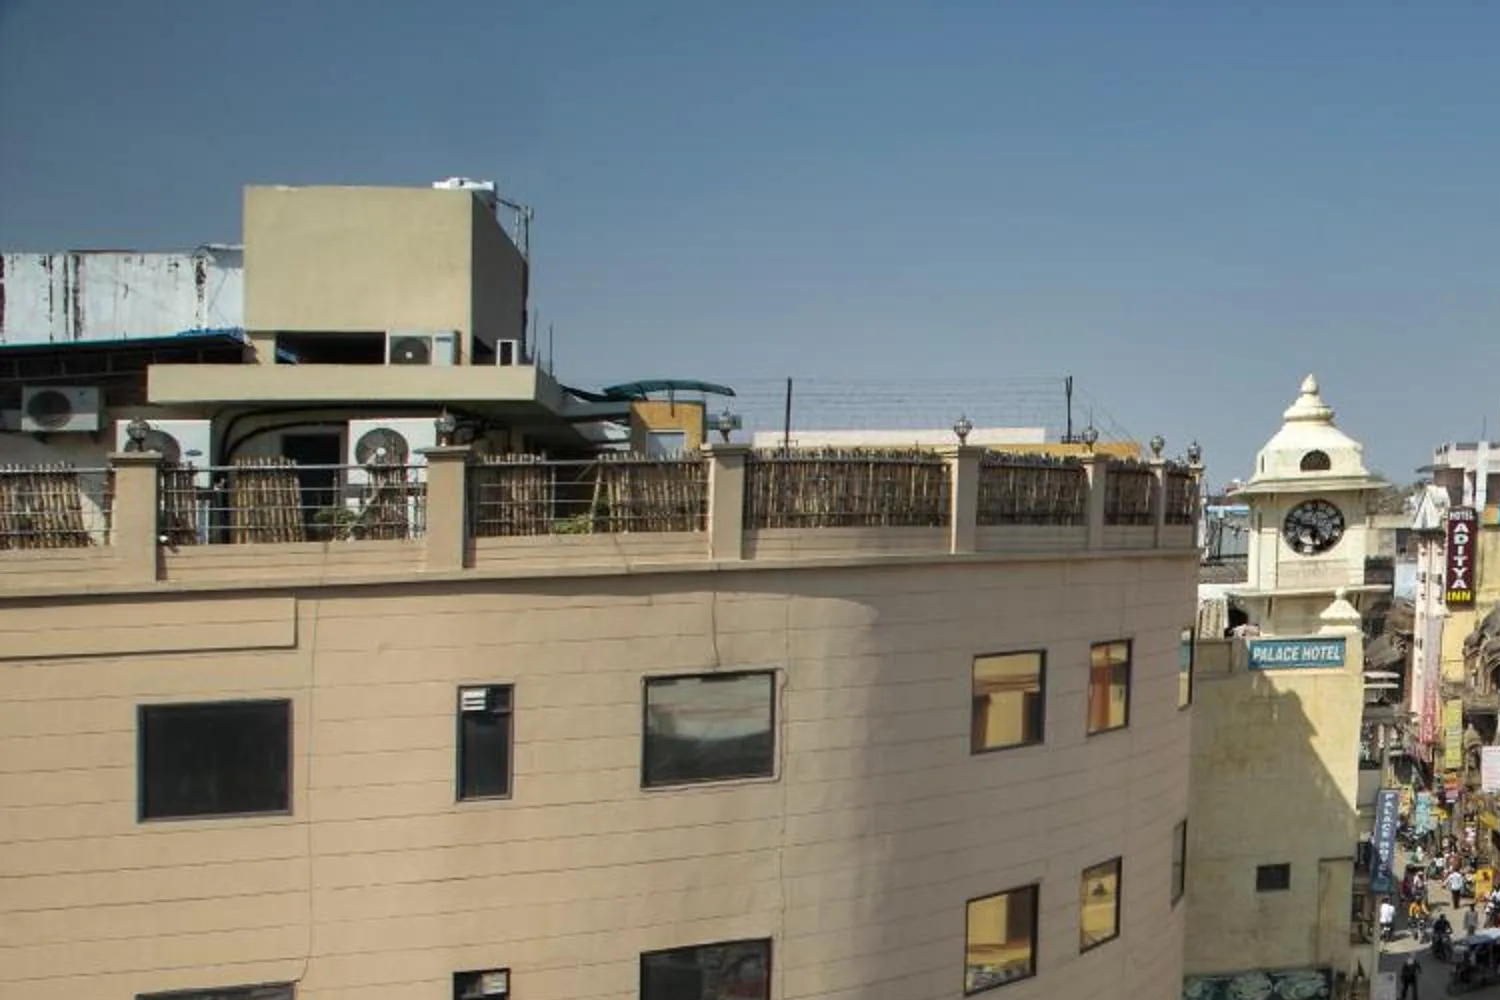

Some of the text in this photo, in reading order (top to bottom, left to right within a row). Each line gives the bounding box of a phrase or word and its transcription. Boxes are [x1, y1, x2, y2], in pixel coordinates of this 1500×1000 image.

[1449, 511, 1473, 521] HOTEL
[1452, 523, 1469, 589] ADITYA
[1447, 591, 1471, 602] INN
[1253, 643, 1341, 662] PALACE HOTEL
